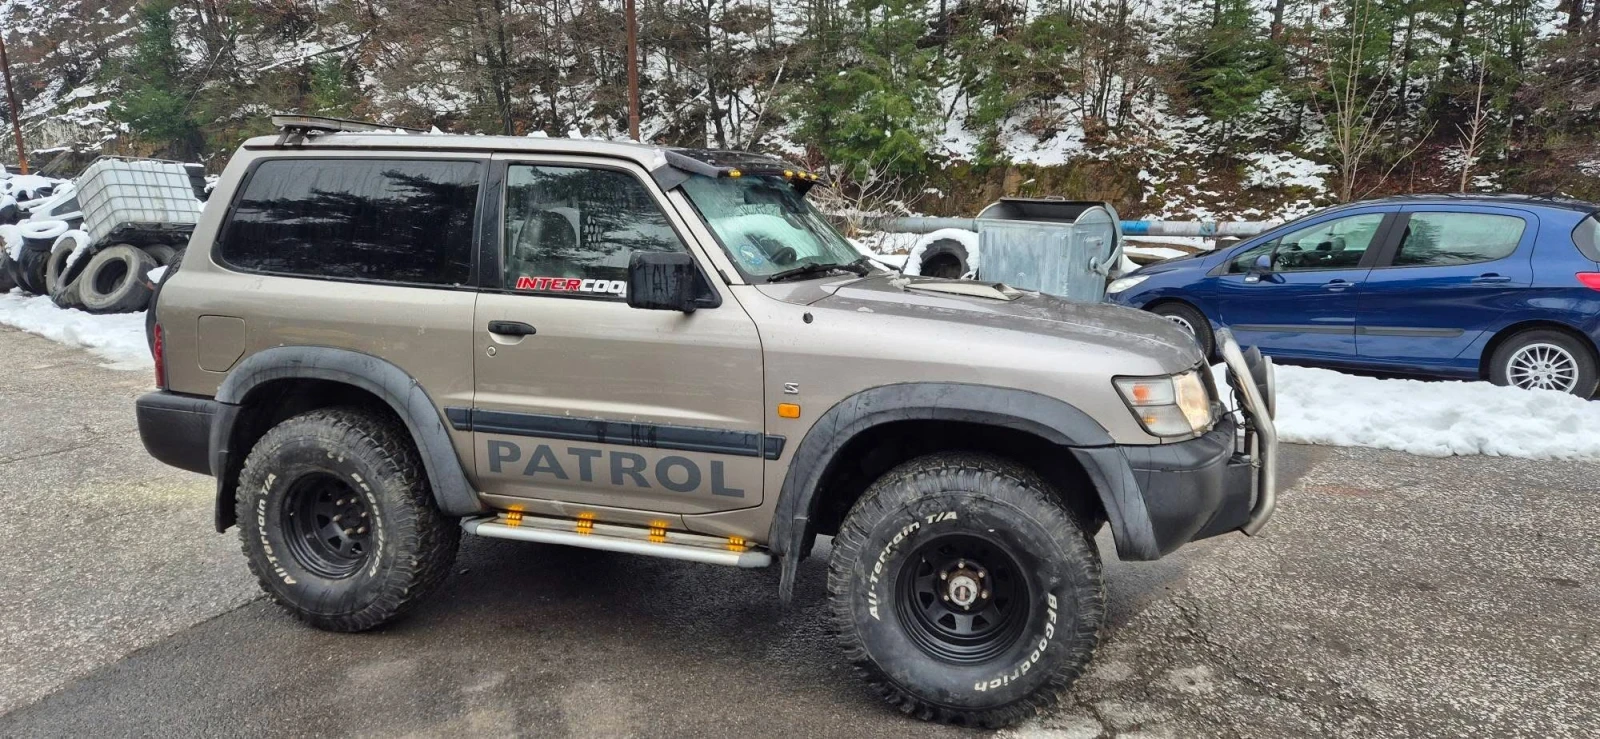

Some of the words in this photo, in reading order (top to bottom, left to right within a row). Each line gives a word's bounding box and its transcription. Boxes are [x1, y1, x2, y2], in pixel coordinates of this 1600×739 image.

[261, 473, 277, 495] T/A
[487, 439, 745, 498] PATROL
[256, 499, 297, 585] All-Terrain
[351, 472, 384, 577] BFGoodrich
[868, 521, 920, 621] All-Terrain
[925, 511, 958, 524] T/A
[974, 593, 1057, 692] BFGoodrich
